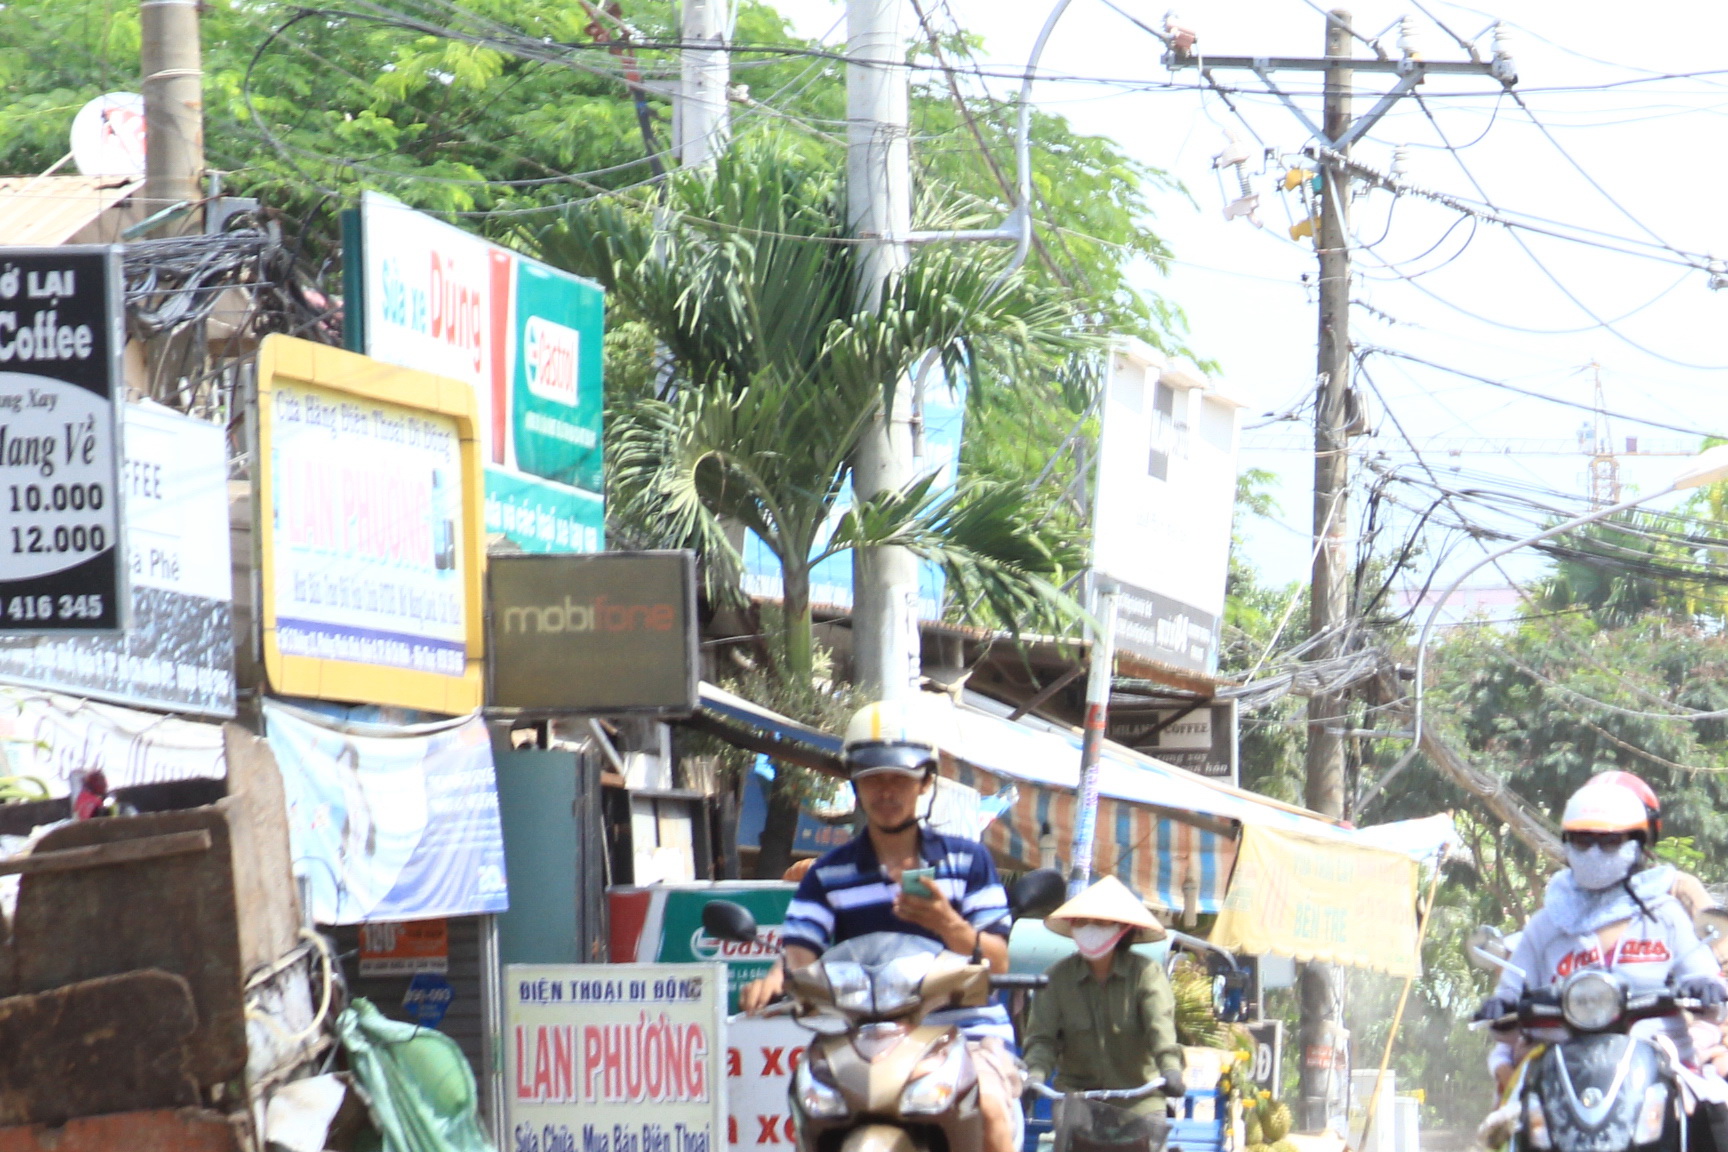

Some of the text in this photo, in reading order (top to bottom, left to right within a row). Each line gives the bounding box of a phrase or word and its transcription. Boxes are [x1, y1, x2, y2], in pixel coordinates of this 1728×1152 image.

[27, 270, 76, 306] LẠI
[0, 310, 93, 361] Coffee
[539, 330, 574, 393] Castrol
[27, 388, 58, 413] Xay
[9, 483, 104, 512] 10.000
[287, 457, 336, 548] LAN
[11, 523, 105, 553] 12.000
[7, 594, 104, 620] 416 345
[503, 594, 676, 635] mobifone
[1164, 722, 1208, 735] COFFEE
[722, 928, 784, 956] Castr
[519, 976, 562, 1005] ĐIỆN
[571, 979, 622, 1005] THOẠI
[630, 980, 646, 1000] DI
[515, 1008, 709, 1105] LAN PHƯƠNG
